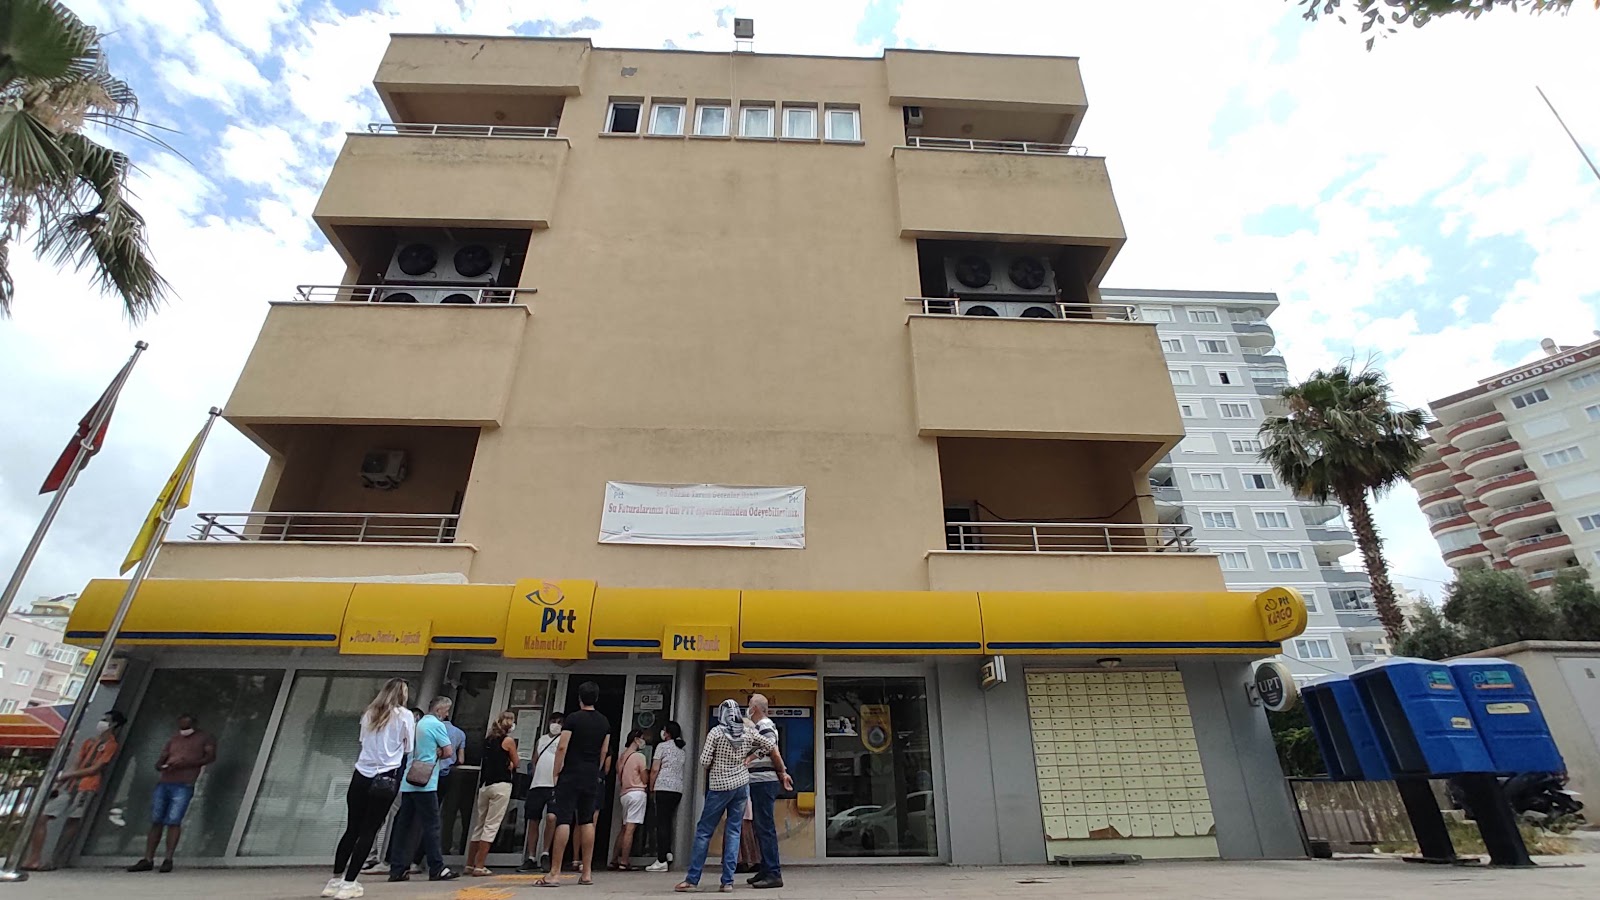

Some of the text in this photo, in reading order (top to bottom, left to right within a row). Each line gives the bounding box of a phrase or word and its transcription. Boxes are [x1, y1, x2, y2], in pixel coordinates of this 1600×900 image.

[1501, 367, 1543, 386] GOLD
[1544, 355, 1576, 372] SUN
[608, 502, 617, 513] Su
[1278, 596, 1290, 607] Ptt
[541, 607, 577, 633] Ptt
[1267, 606, 1293, 626] KARGO
[524, 635, 567, 651] Mahmutlar
[1257, 676, 1280, 694] UPT
